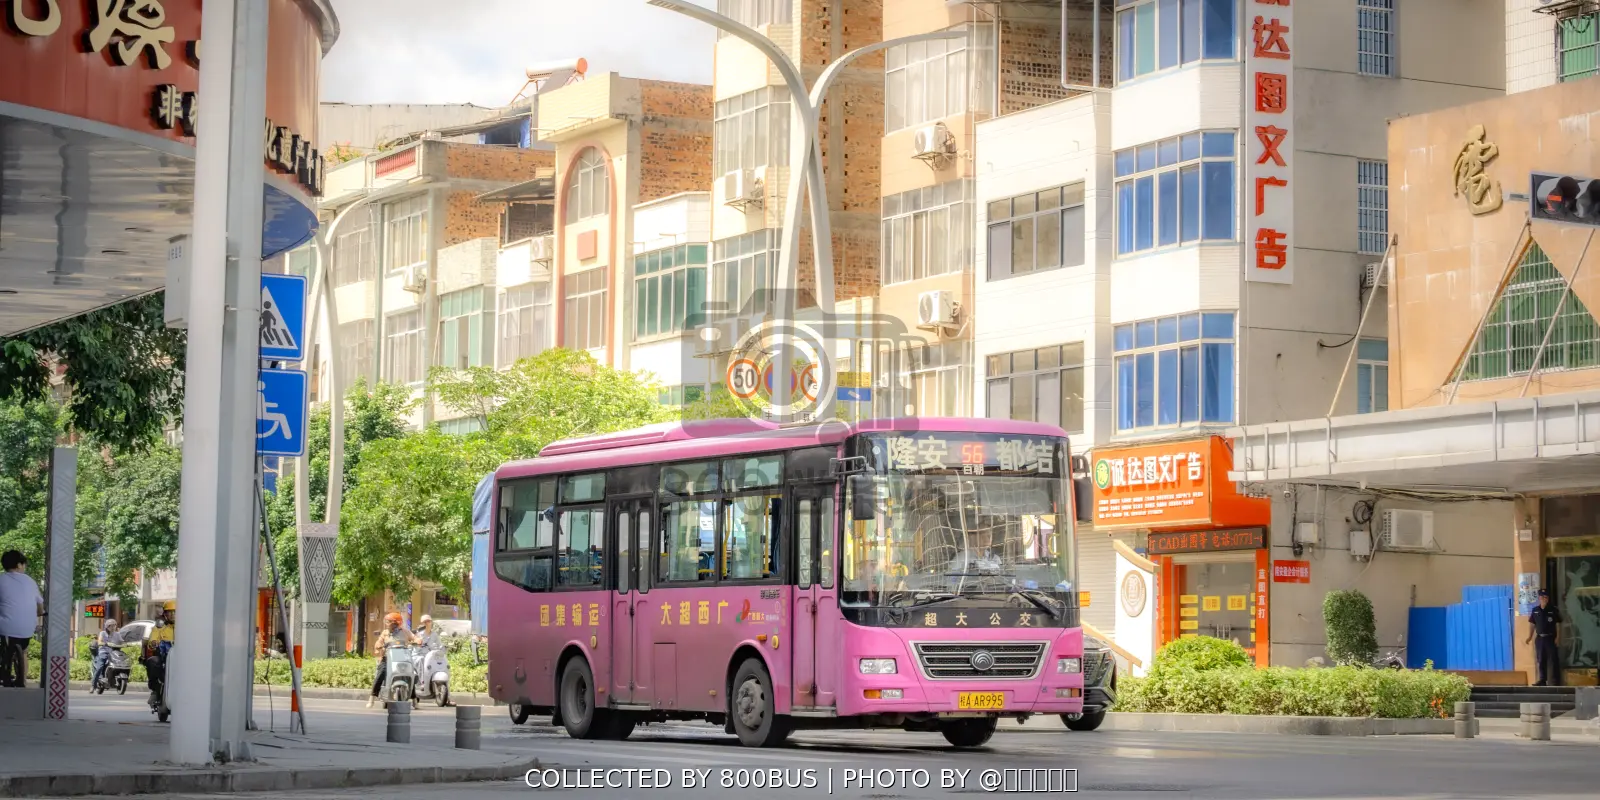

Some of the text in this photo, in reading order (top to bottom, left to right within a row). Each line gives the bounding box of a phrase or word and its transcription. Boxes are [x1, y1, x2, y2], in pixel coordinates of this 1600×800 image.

[1251, 0, 1290, 270] 达图文广告
[733, 367, 755, 390] 50
[887, 436, 1053, 474] 隆安 56 都结
[963, 464, 985, 475] 百朝
[1111, 452, 1202, 487] 诚达图文广告
[925, 612, 1031, 627] 超大公交
